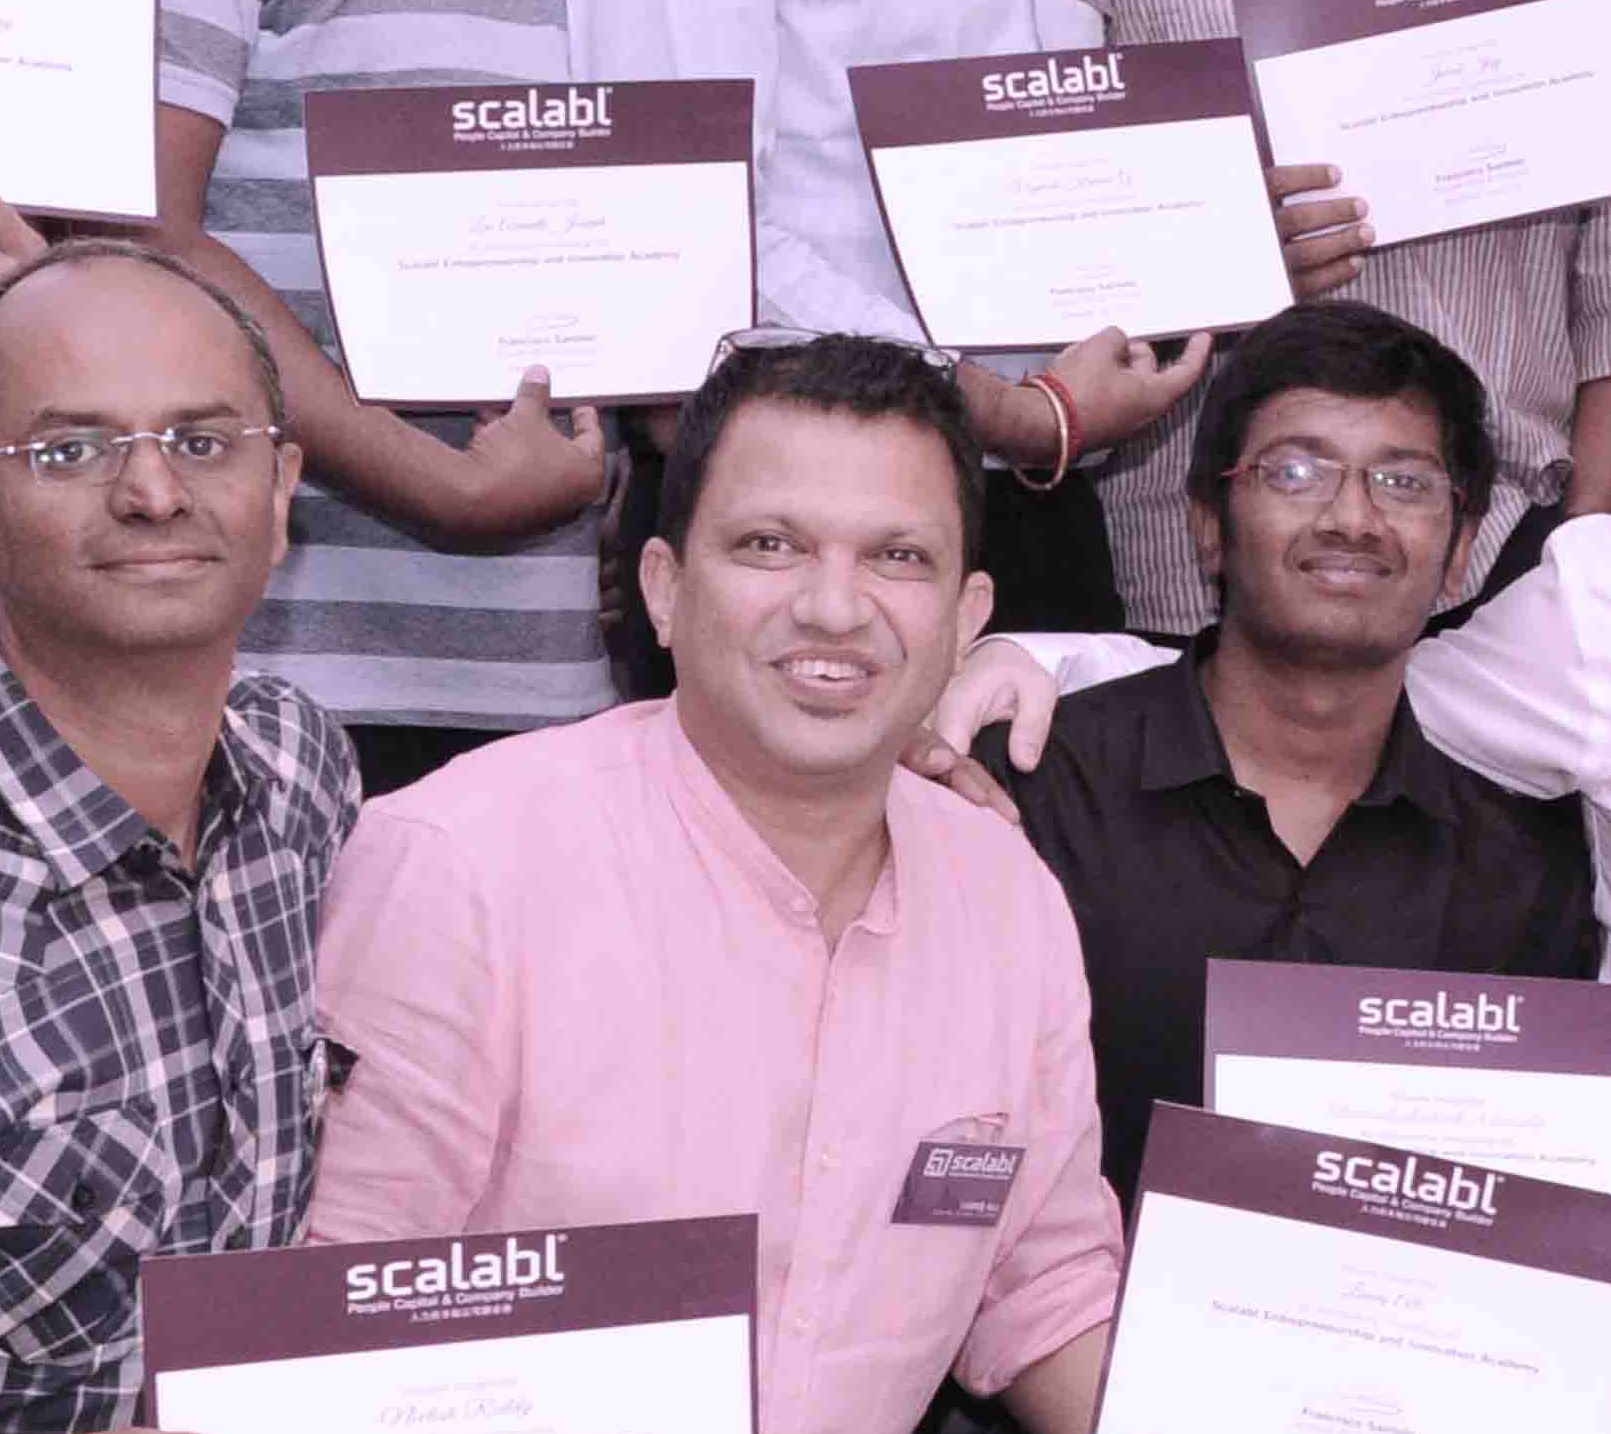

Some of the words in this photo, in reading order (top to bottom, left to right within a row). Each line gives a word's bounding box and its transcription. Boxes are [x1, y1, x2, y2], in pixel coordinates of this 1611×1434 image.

[982, 53, 1125, 101] scalabl
[452, 87, 612, 130] scalabl
[1359, 991, 1520, 1033] scalabl
[1314, 1150, 1496, 1213] scalabl
[347, 1234, 564, 1299] scalabl
